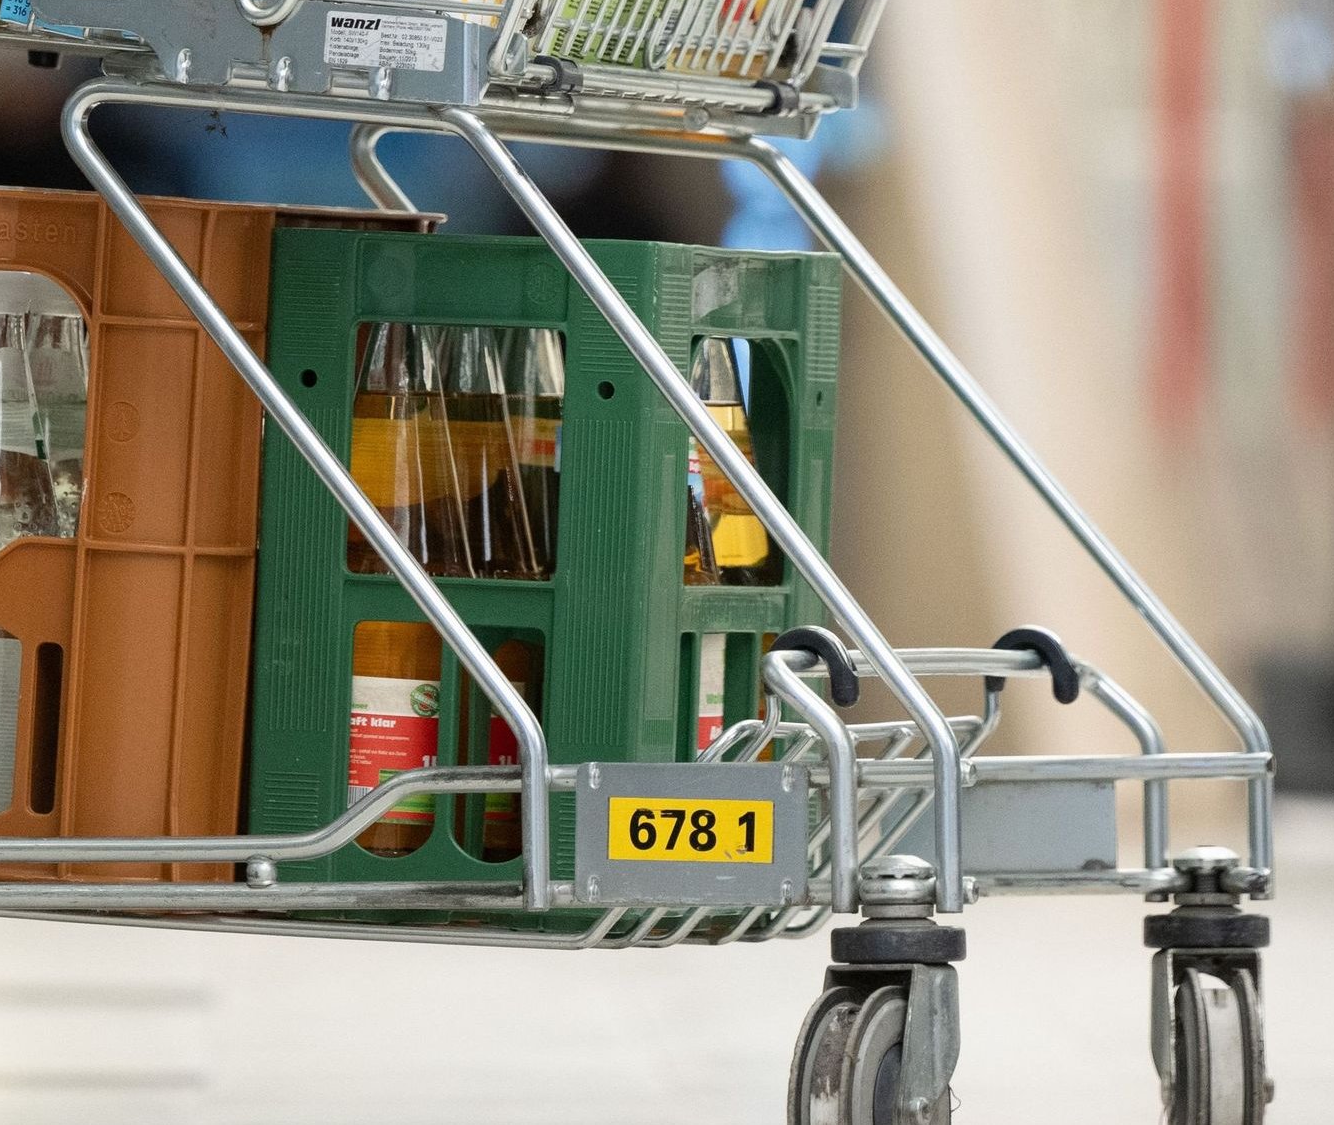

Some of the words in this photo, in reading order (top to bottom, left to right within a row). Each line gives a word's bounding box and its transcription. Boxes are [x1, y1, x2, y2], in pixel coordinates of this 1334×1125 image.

[13, 5, 27, 17] 316
[331, 17, 381, 30] wanzl
[370, 717, 397, 728] klar
[630, 808, 717, 852] 678
[738, 811, 756, 852] 1
